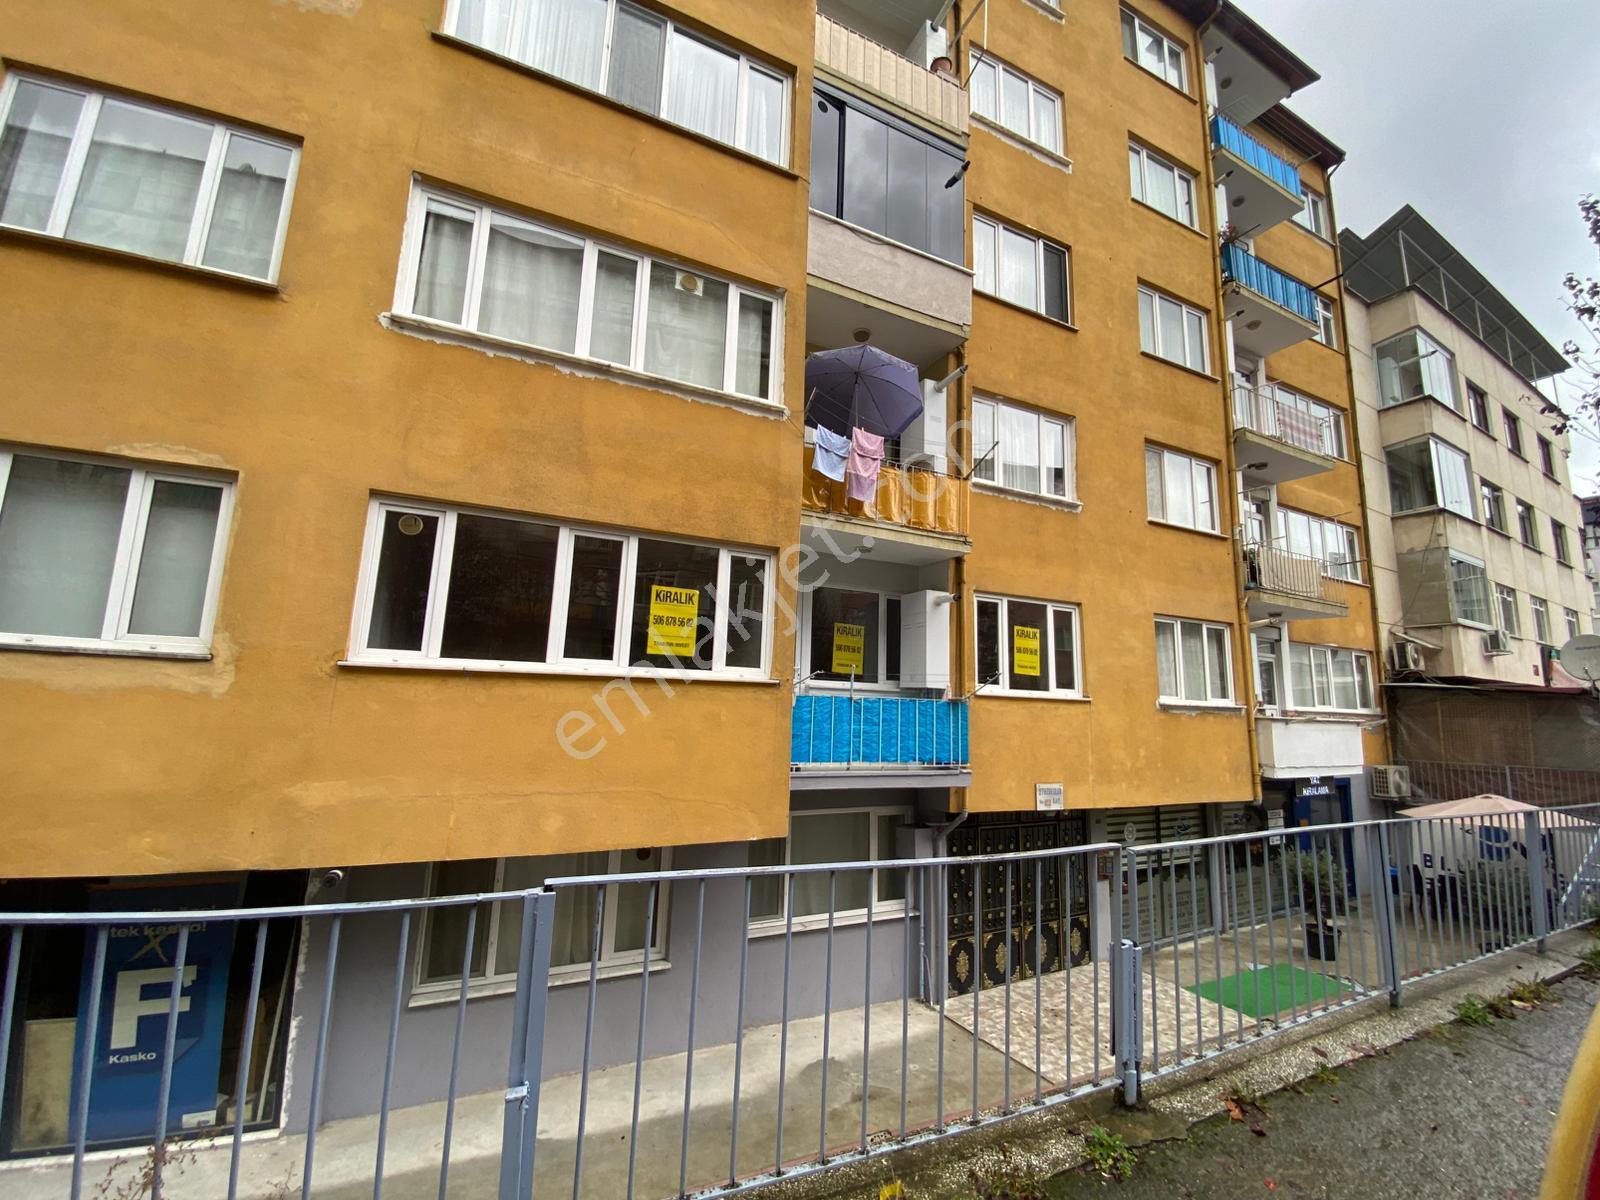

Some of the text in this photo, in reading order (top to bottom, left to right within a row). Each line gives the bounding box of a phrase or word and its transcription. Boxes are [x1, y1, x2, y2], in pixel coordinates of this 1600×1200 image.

[653, 614, 665, 626] 506
[665, 615, 677, 627] 878
[677, 616, 686, 627] 56
[110, 921, 208, 938] tek kaso!
[109, 1051, 157, 1065] Kasko
